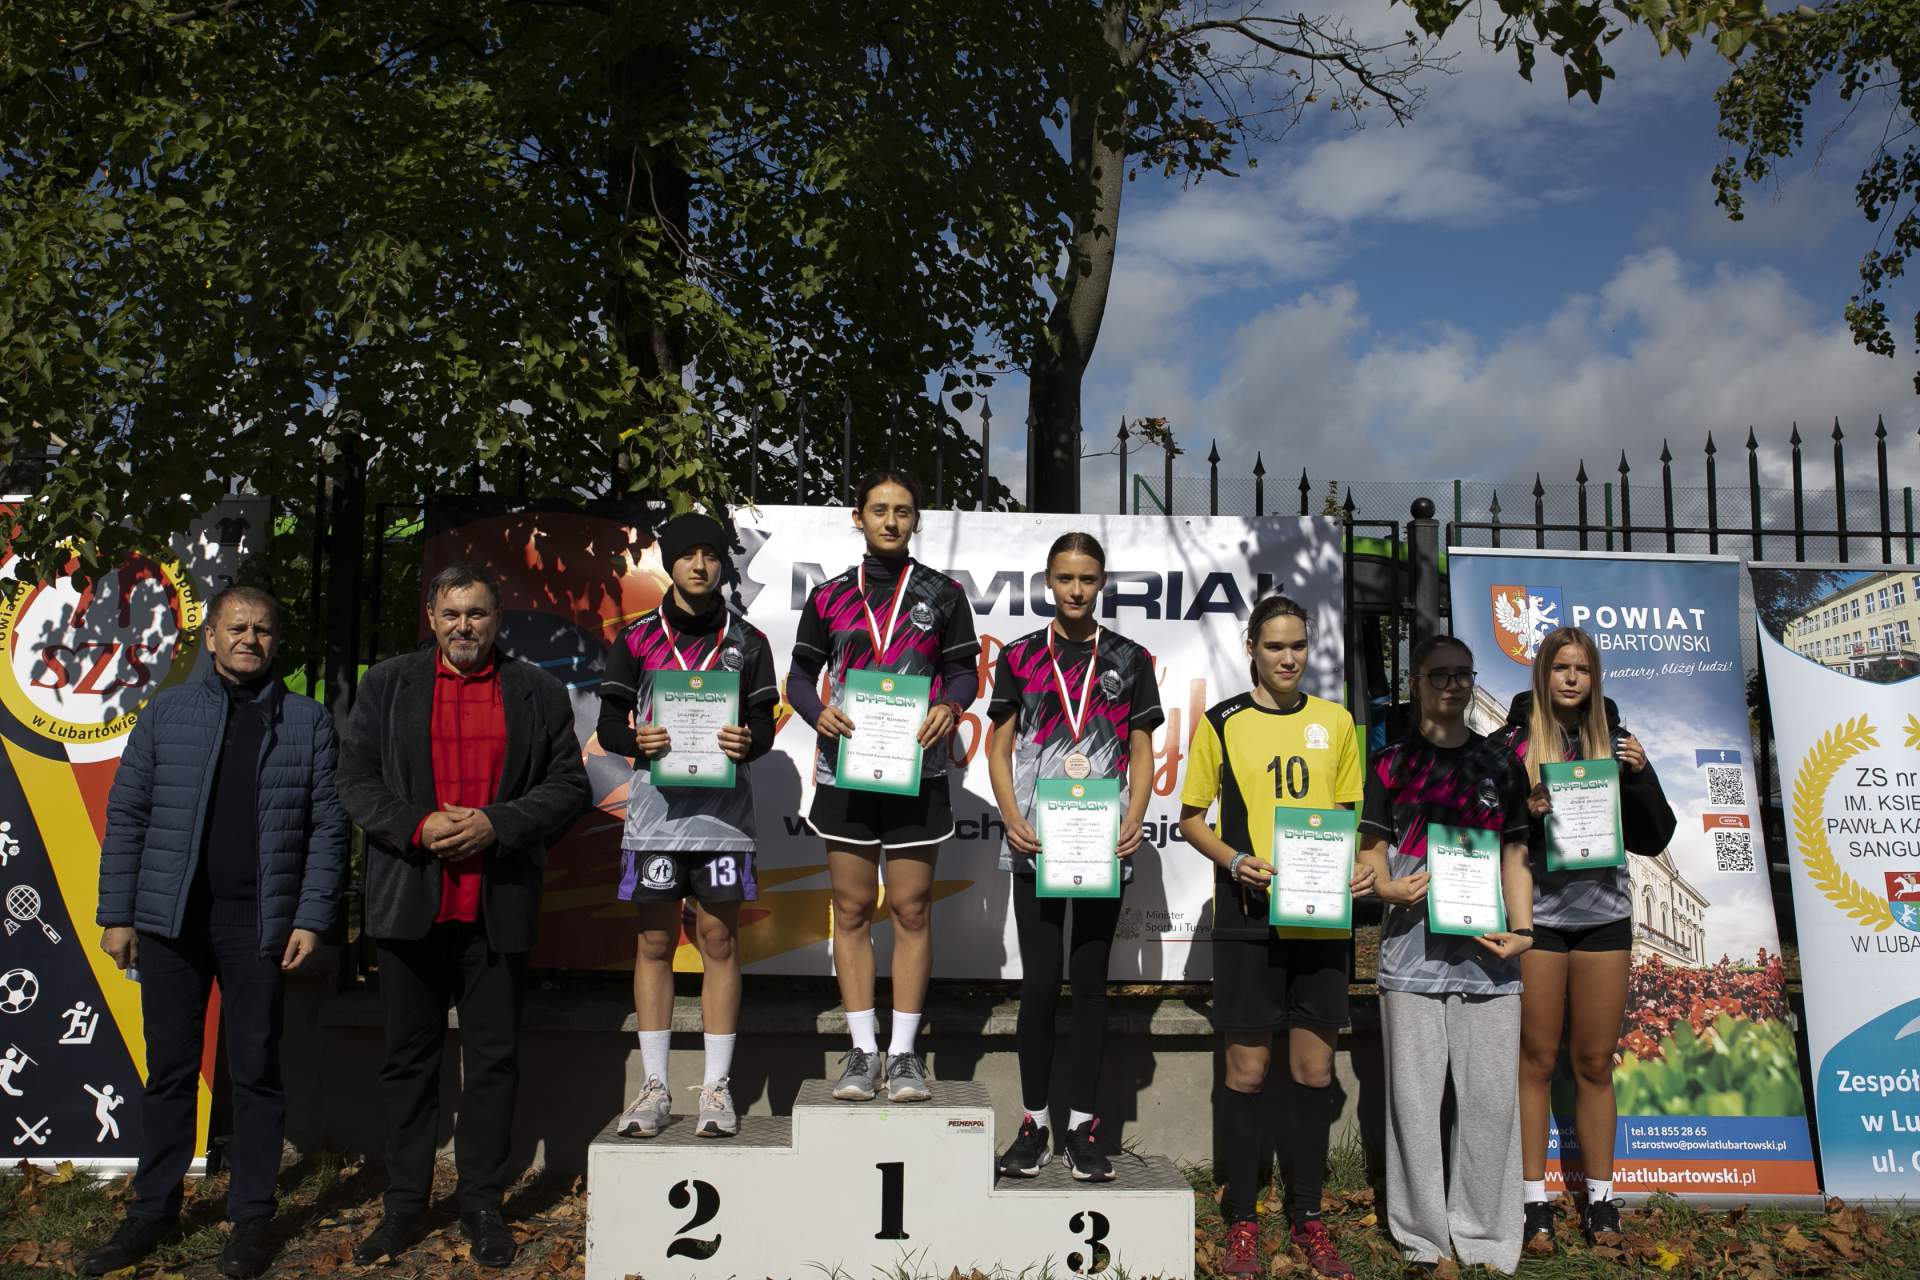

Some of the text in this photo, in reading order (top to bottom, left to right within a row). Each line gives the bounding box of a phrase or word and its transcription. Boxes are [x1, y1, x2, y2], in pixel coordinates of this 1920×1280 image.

[1572, 605, 1705, 631] POWIAT
[1594, 633, 1711, 653] UBARTOWSKI
[30, 642, 158, 694] SZS
[1610, 667, 1659, 680] natury,
[1661, 661, 1696, 677] bliżej
[1698, 660, 1733, 673] ludzi!
[664, 692, 727, 703] DYPLOM
[856, 692, 917, 708] DYPLOM
[32, 715, 137, 740] w Lubartowie
[1266, 755, 1310, 800] 10
[1552, 779, 1608, 792] DYPLOM
[1855, 767, 1917, 787] ZS nr
[1047, 800, 1108, 811] DYPLOM
[1844, 795, 1872, 811] IM.
[1284, 828, 1345, 842] DYPLOM
[1827, 818, 1897, 834] PAWŁA
[1437, 846, 1490, 860] DYPLOM
[705, 856, 736, 887] 13
[1146, 911, 1184, 920] Minister
[1145, 922, 1177, 933] Sportu
[1850, 935, 1870, 953] W
[1836, 1068, 1920, 1097] Zespół
[1631, 1127, 1707, 1137] tel. 81 855 28 65
[1860, 1115, 1884, 1132] w
[1632, 1139, 1787, 1151] starostwo@powiatlubartowski.pl
[1872, 1148, 1904, 1173] ul.
[874, 1161, 911, 1240] 1
[666, 1179, 722, 1260] 2
[1066, 1210, 1111, 1275] 3
